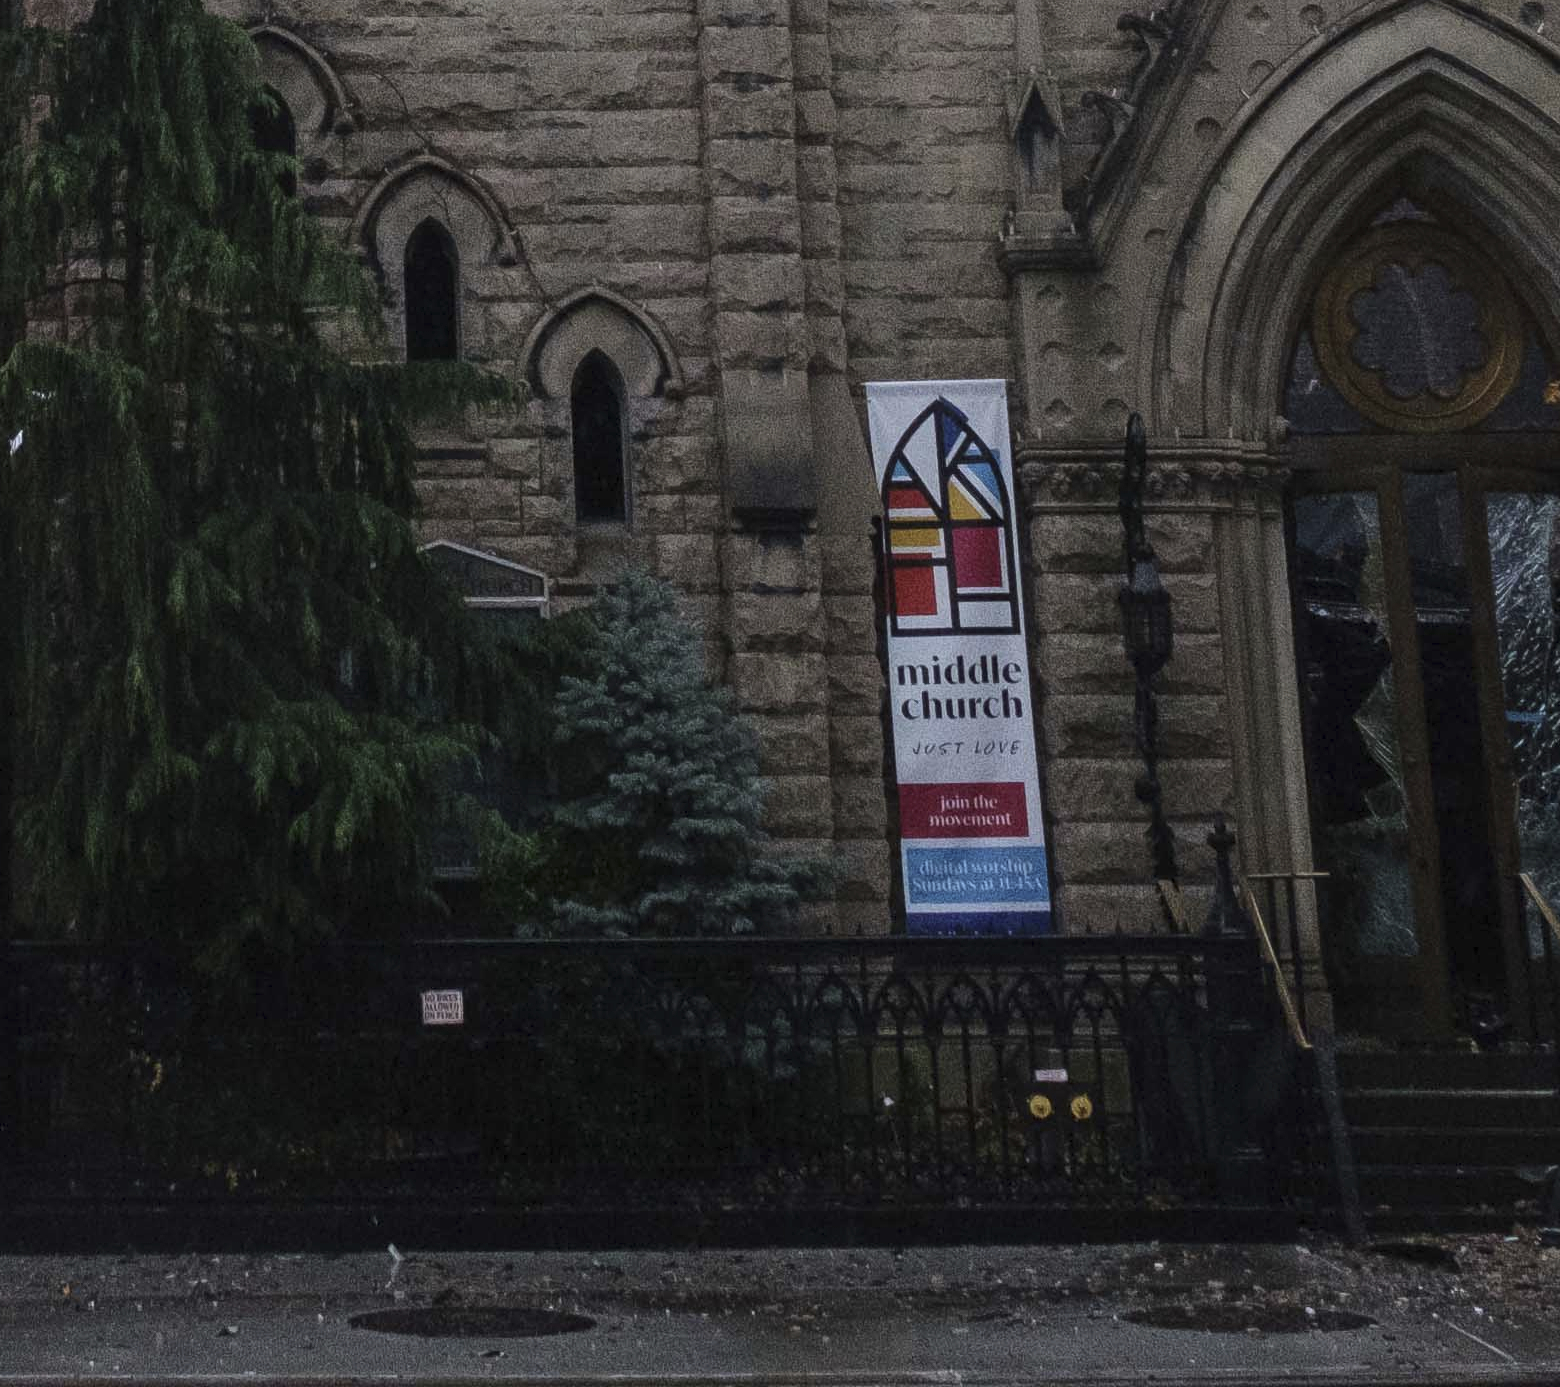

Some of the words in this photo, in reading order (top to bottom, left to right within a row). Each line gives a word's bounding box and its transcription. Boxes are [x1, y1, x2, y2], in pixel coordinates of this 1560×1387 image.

[897, 655, 1022, 685] middle
[901, 689, 1023, 720] church
[912, 741, 965, 756] JUST
[974, 740, 1021, 755] LOVE
[940, 795, 971, 813] join
[972, 793, 998, 810] the
[928, 811, 1012, 828] movement
[919, 858, 969, 877] digital
[970, 857, 1033, 877] worship
[912, 877, 978, 895] Sundays
[979, 878, 995, 893] at
